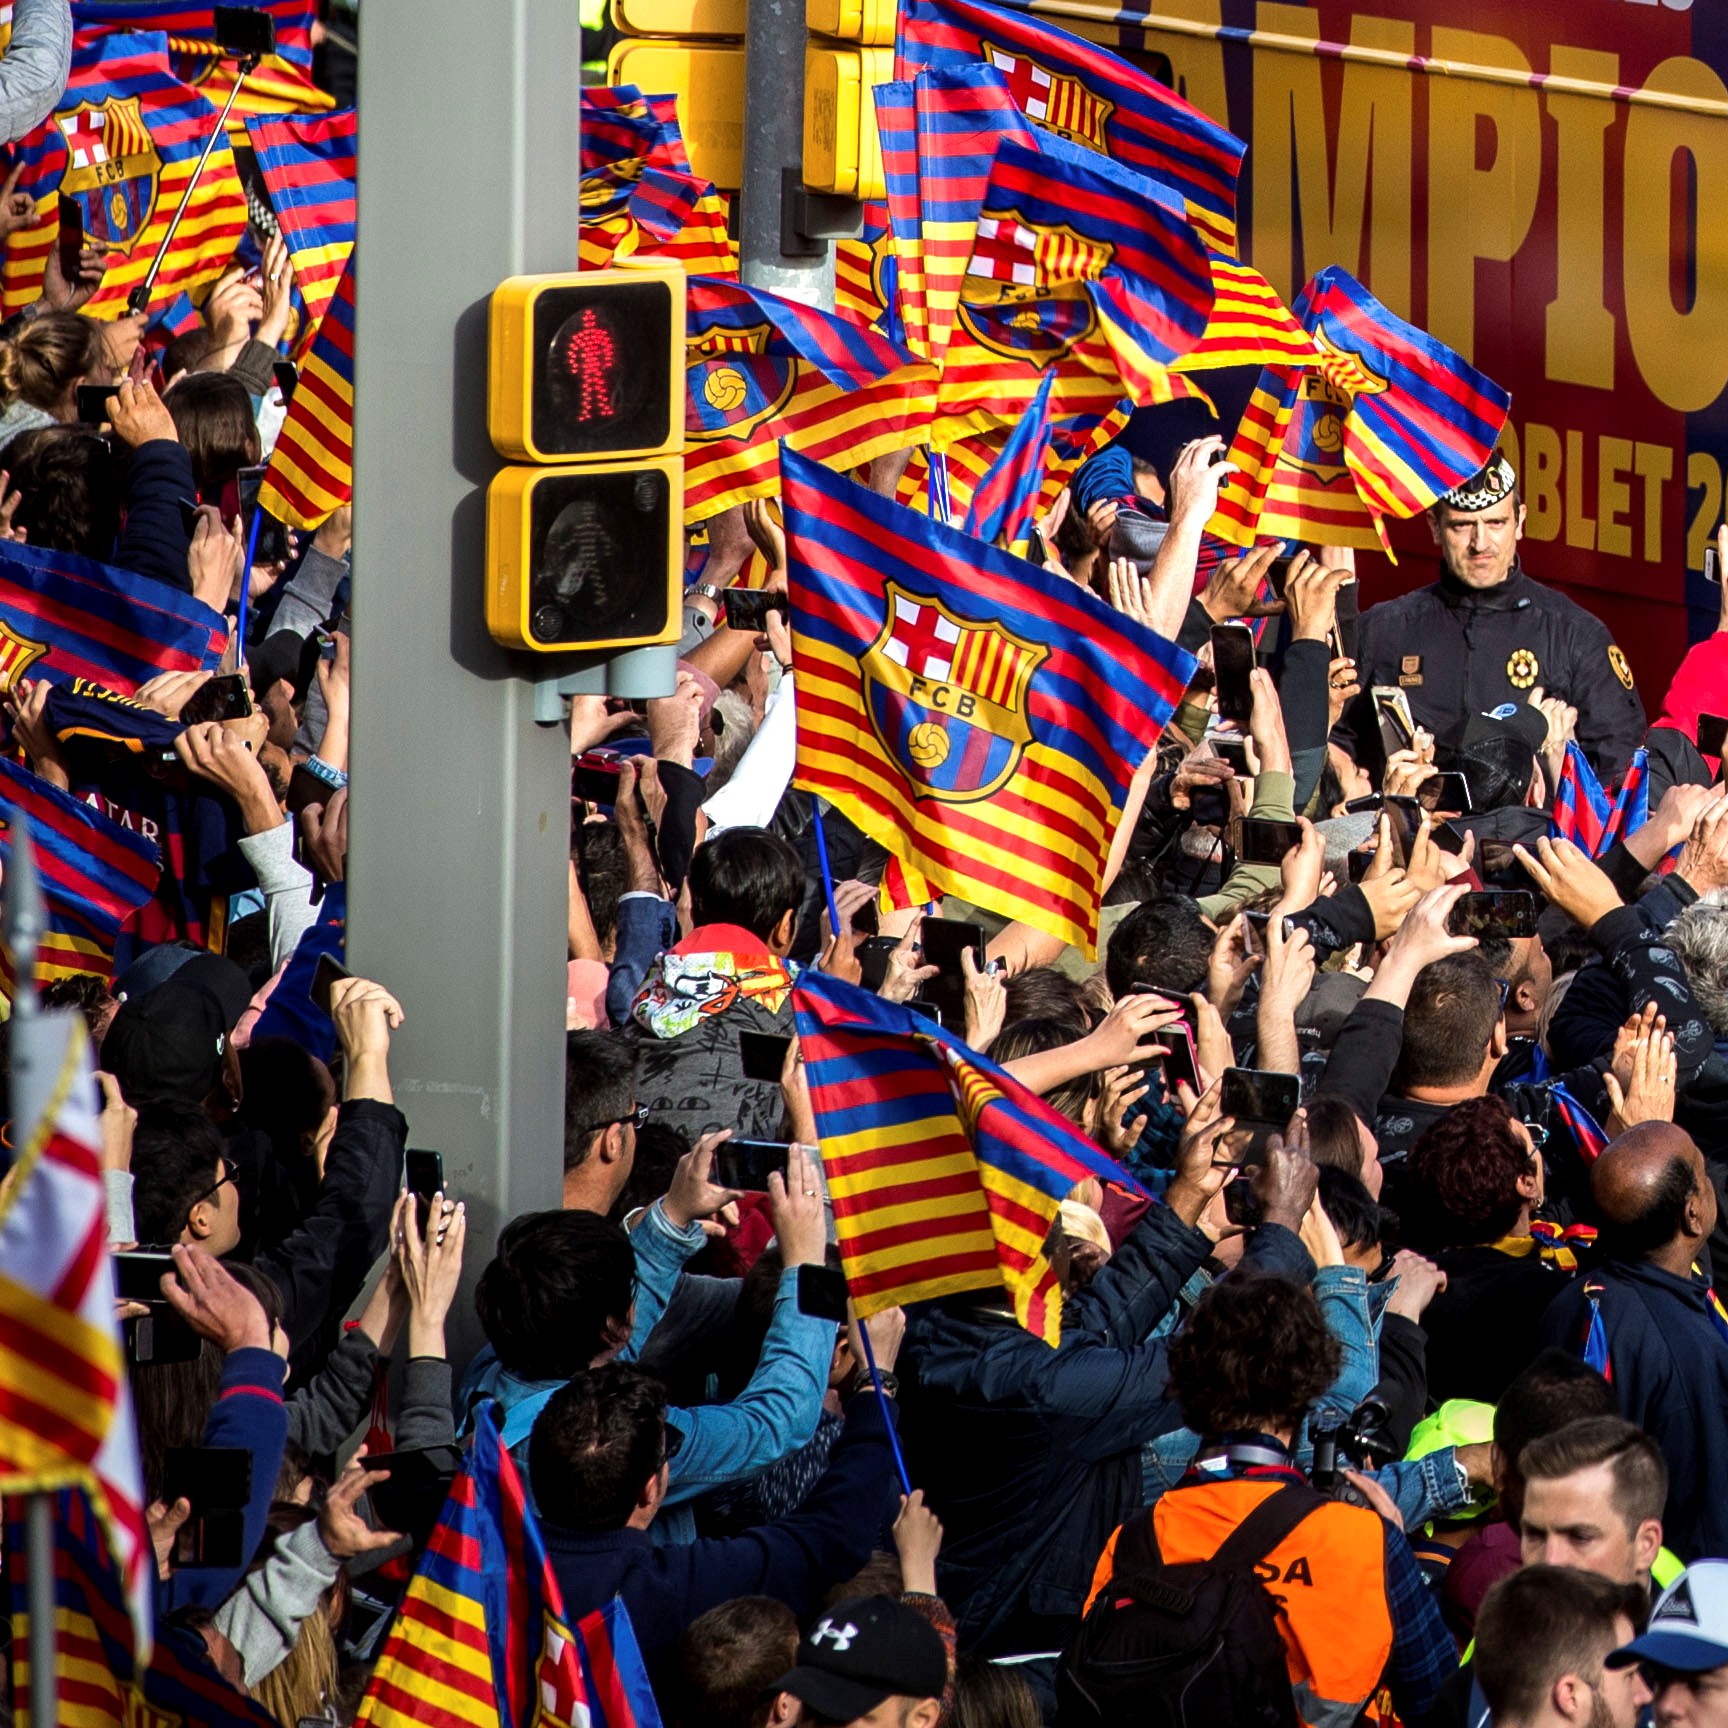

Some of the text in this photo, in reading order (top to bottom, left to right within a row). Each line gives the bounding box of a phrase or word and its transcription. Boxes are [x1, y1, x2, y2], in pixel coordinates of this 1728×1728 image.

[95, 159, 127, 188] FCB
[1500, 420, 1676, 565] BLET
[906, 678, 977, 722] FCB
